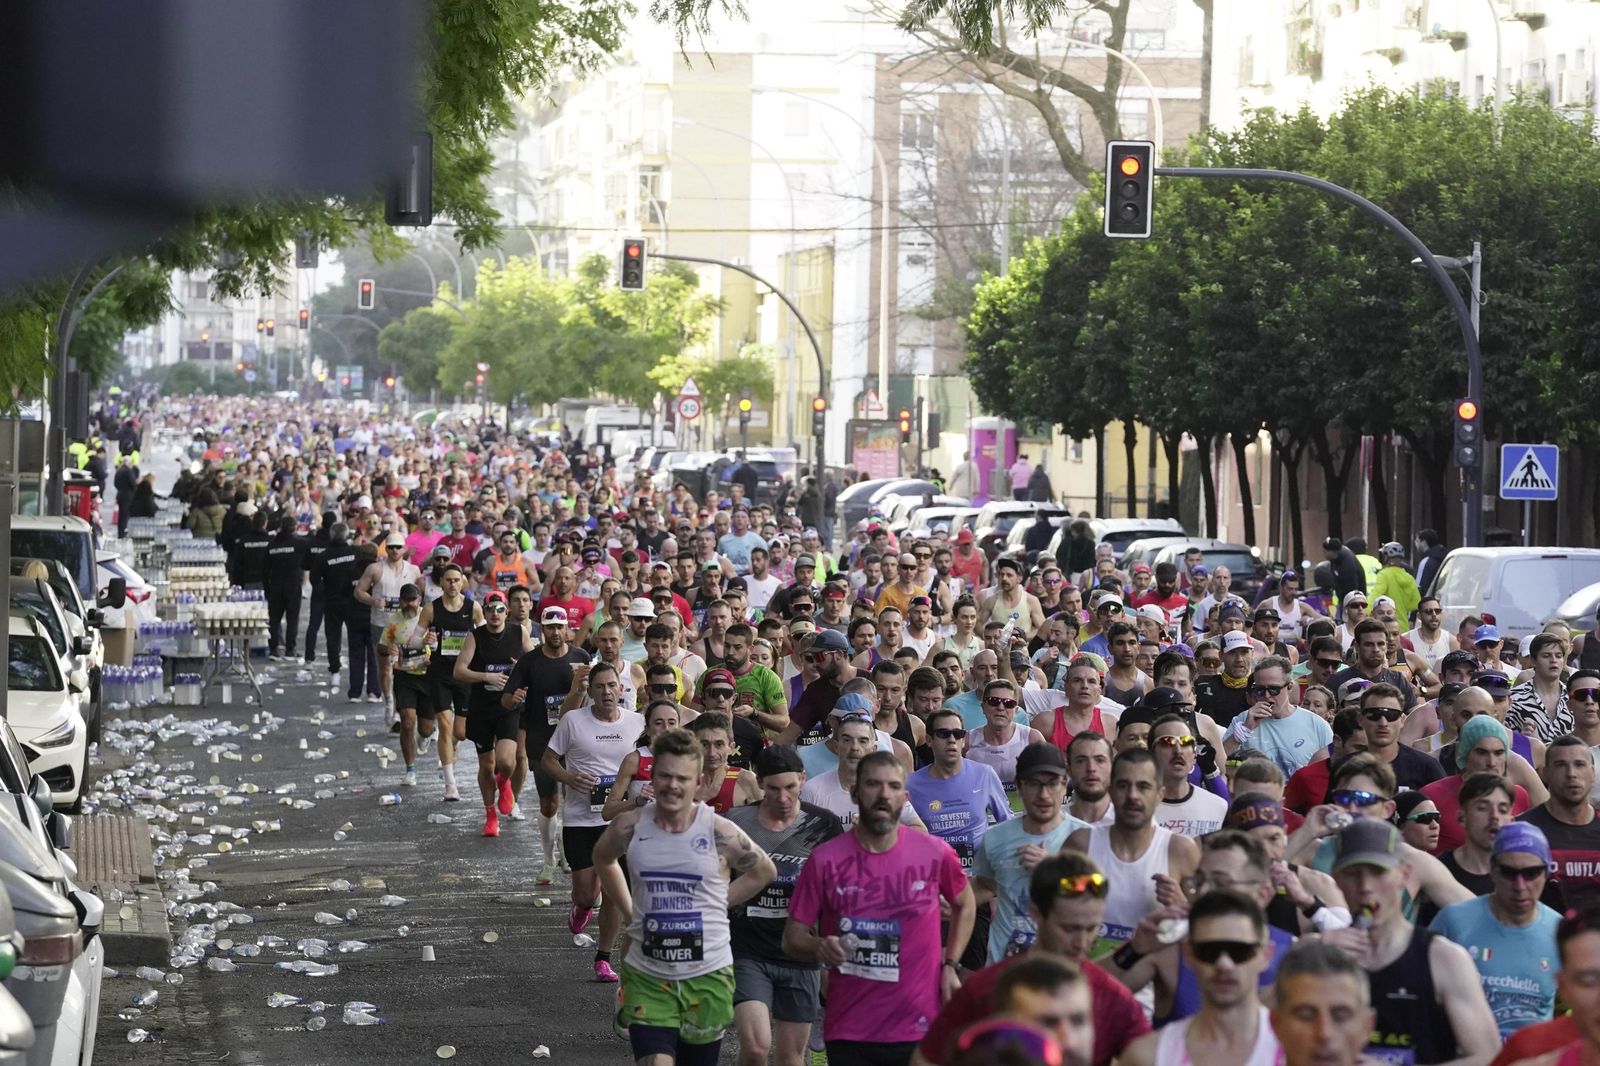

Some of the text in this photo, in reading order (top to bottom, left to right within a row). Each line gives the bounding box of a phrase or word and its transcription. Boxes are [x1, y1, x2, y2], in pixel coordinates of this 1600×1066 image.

[683, 404, 697, 412] 30
[269, 546, 295, 555] VOLUNTEER
[327, 554, 356, 566] VOLUNTEER
[646, 881, 697, 896] WYE VALLEY
[767, 888, 784, 896] 4443
[651, 897, 693, 911] RUNNERS
[661, 920, 697, 930] ZURICH
[855, 921, 894, 932] ZURICH
[652, 948, 693, 961] OLIVER
[1480, 975, 1541, 994] recchiella
